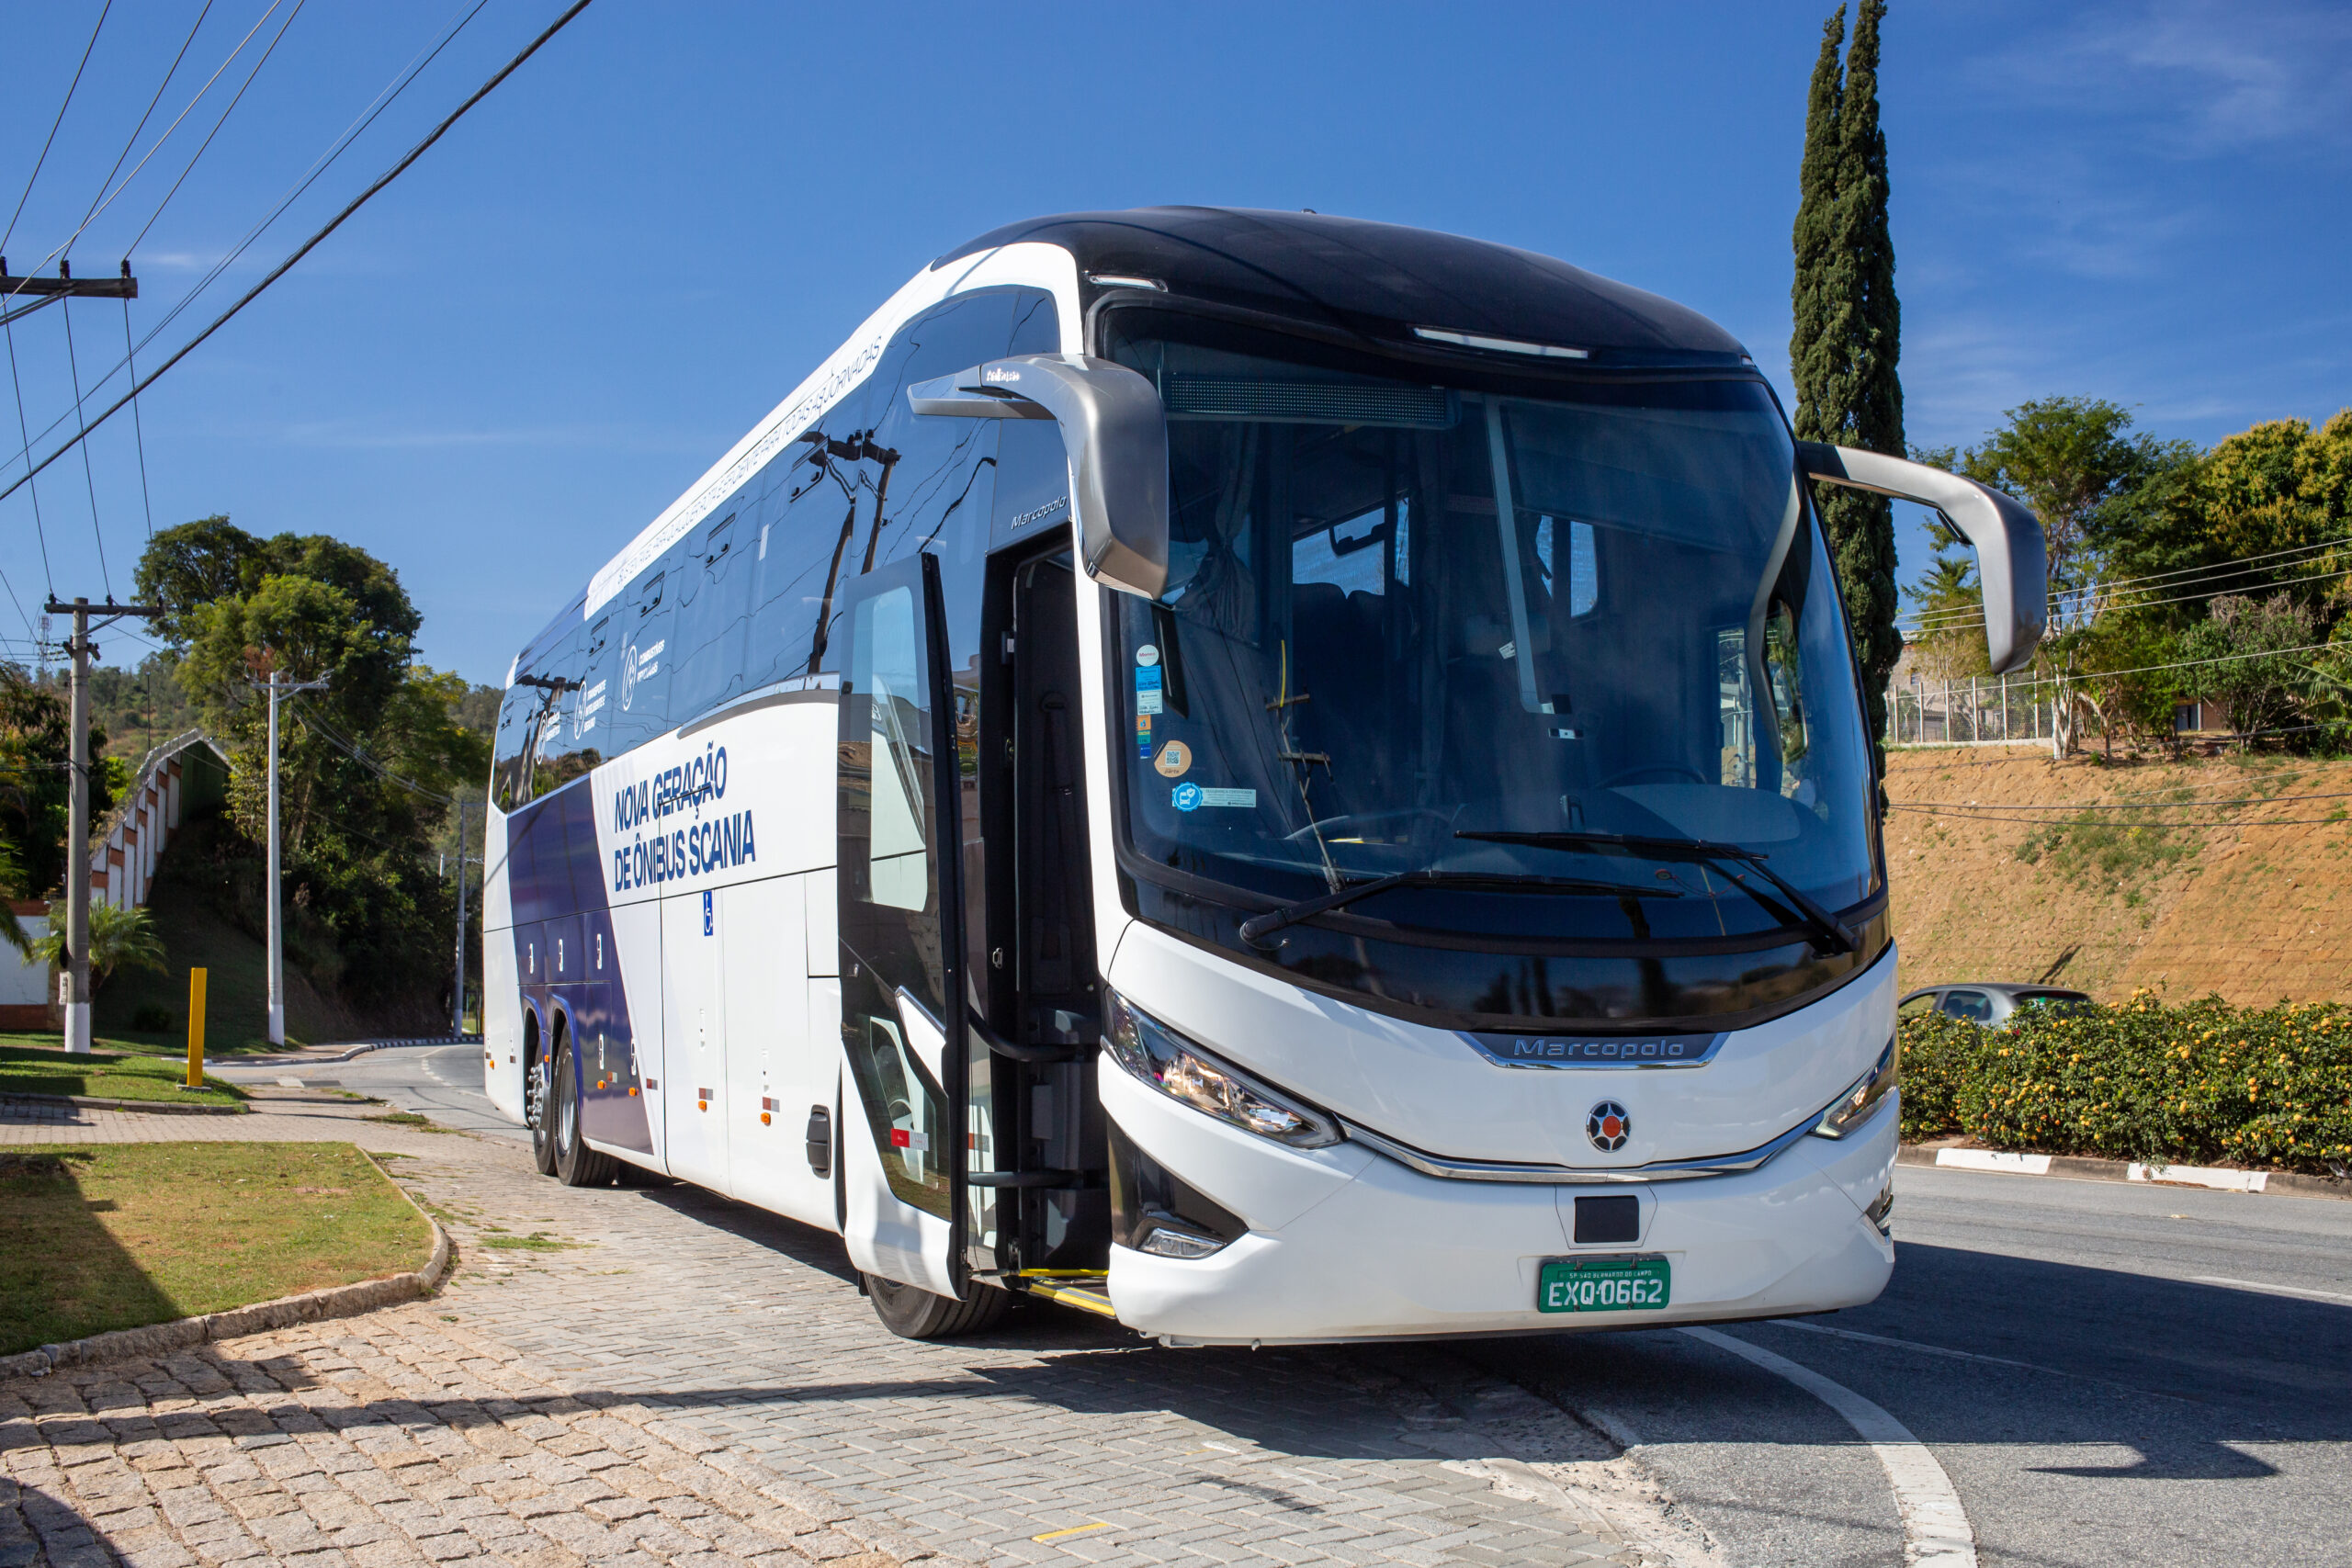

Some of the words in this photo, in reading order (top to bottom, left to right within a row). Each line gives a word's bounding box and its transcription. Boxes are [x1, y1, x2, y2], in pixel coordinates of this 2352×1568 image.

[822, 334, 882, 404] JORNADAS
[1011, 495, 1067, 530] Marcopolo
[615, 779, 650, 834] NOVA
[651, 739, 728, 820] GERAÇÃO
[615, 846, 632, 893] DE
[633, 829, 686, 889] ÔNIBUS
[688, 809, 756, 876] SCANIA
[1513, 1039, 1684, 1058] Marcopolo
[1592, 1270, 1623, 1279] BERNARDO
